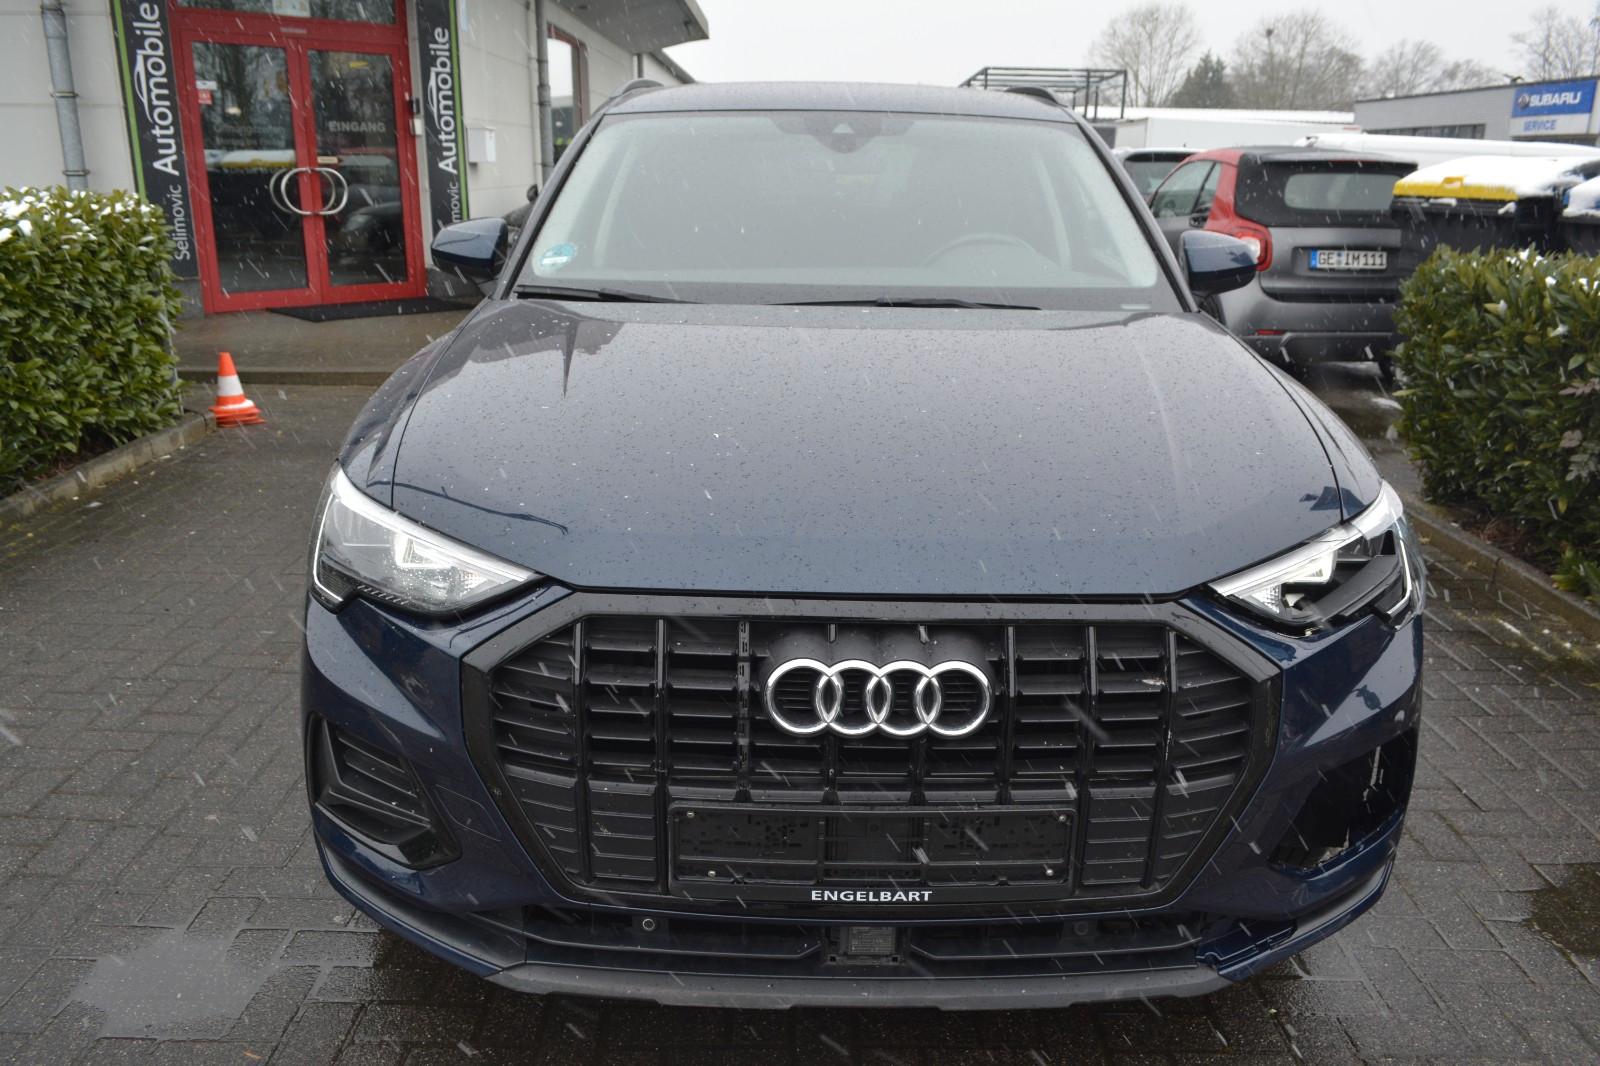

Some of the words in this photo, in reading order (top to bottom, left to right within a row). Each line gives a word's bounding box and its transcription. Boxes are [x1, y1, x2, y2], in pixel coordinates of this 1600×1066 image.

[132, 2, 179, 176] Automobile
[428, 27, 458, 175] Automobile
[1529, 91, 1582, 107] SUBARU
[328, 121, 386, 132] EINGANG
[167, 184, 190, 260] Selimovic
[447, 181, 462, 223] movic
[811, 890, 933, 902] ENGELBART
